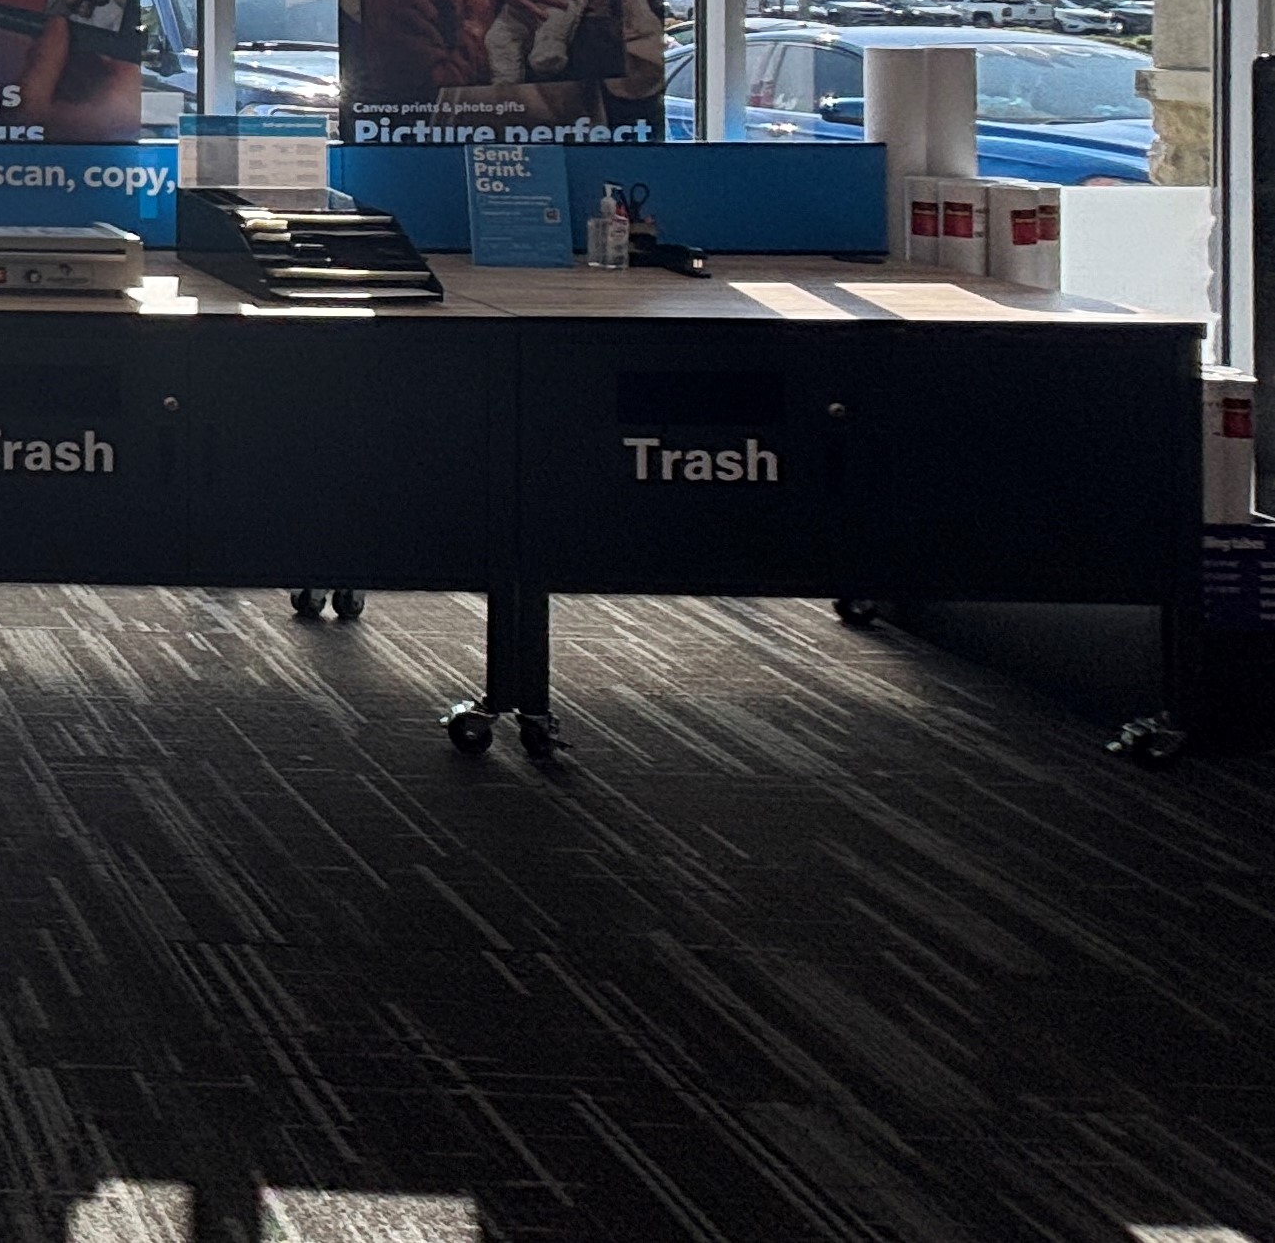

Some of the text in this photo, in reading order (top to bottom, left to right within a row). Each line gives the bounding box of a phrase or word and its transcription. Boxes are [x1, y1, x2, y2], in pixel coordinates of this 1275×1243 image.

[353, 101, 526, 116] Canvas prints & photo gifts
[354, 116, 652, 143] Picture perfect
[473, 145, 530, 162] Send.
[474, 161, 532, 177] Print.
[83, 165, 176, 197] copy,
[476, 177, 510, 193] Go.
[622, 437, 779, 482] Trash
